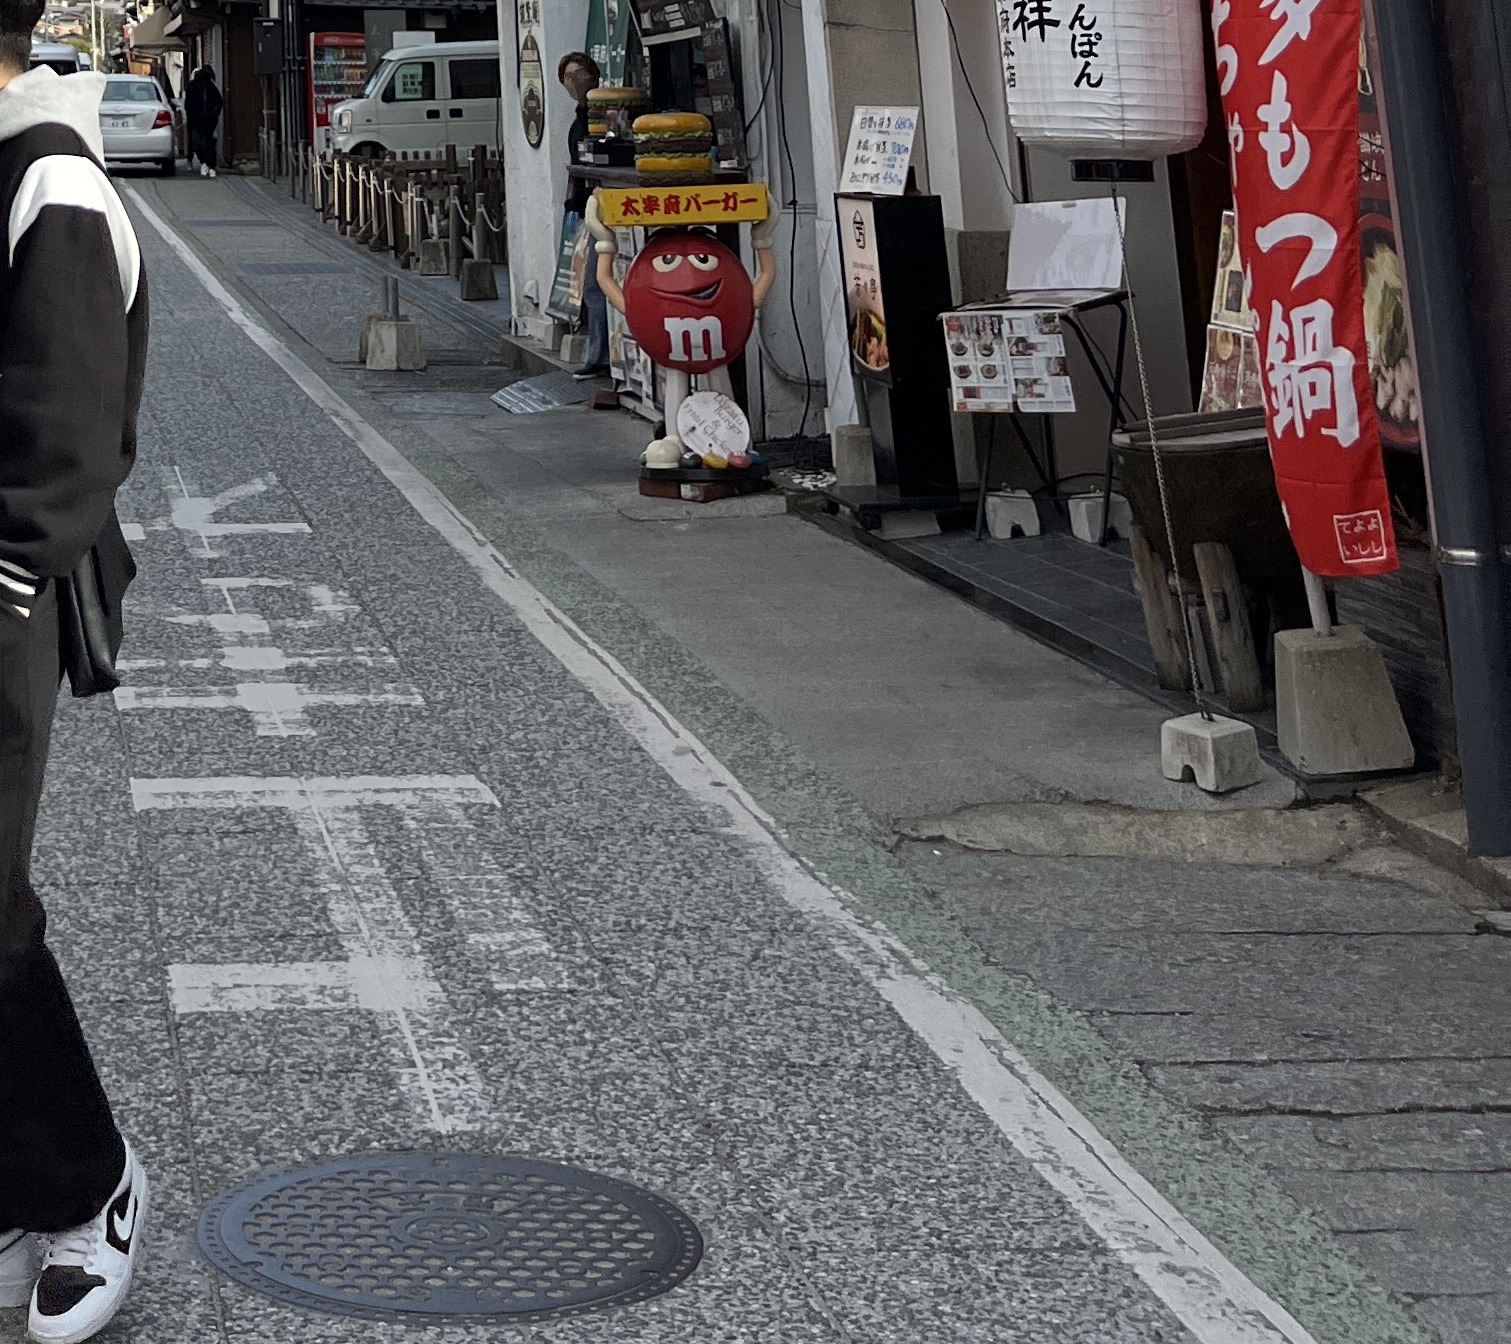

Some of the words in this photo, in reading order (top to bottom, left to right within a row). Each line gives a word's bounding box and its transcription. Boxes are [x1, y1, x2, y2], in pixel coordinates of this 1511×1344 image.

[620, 191, 759, 217] 太宰府バーガー
[664, 314, 727, 362] m
